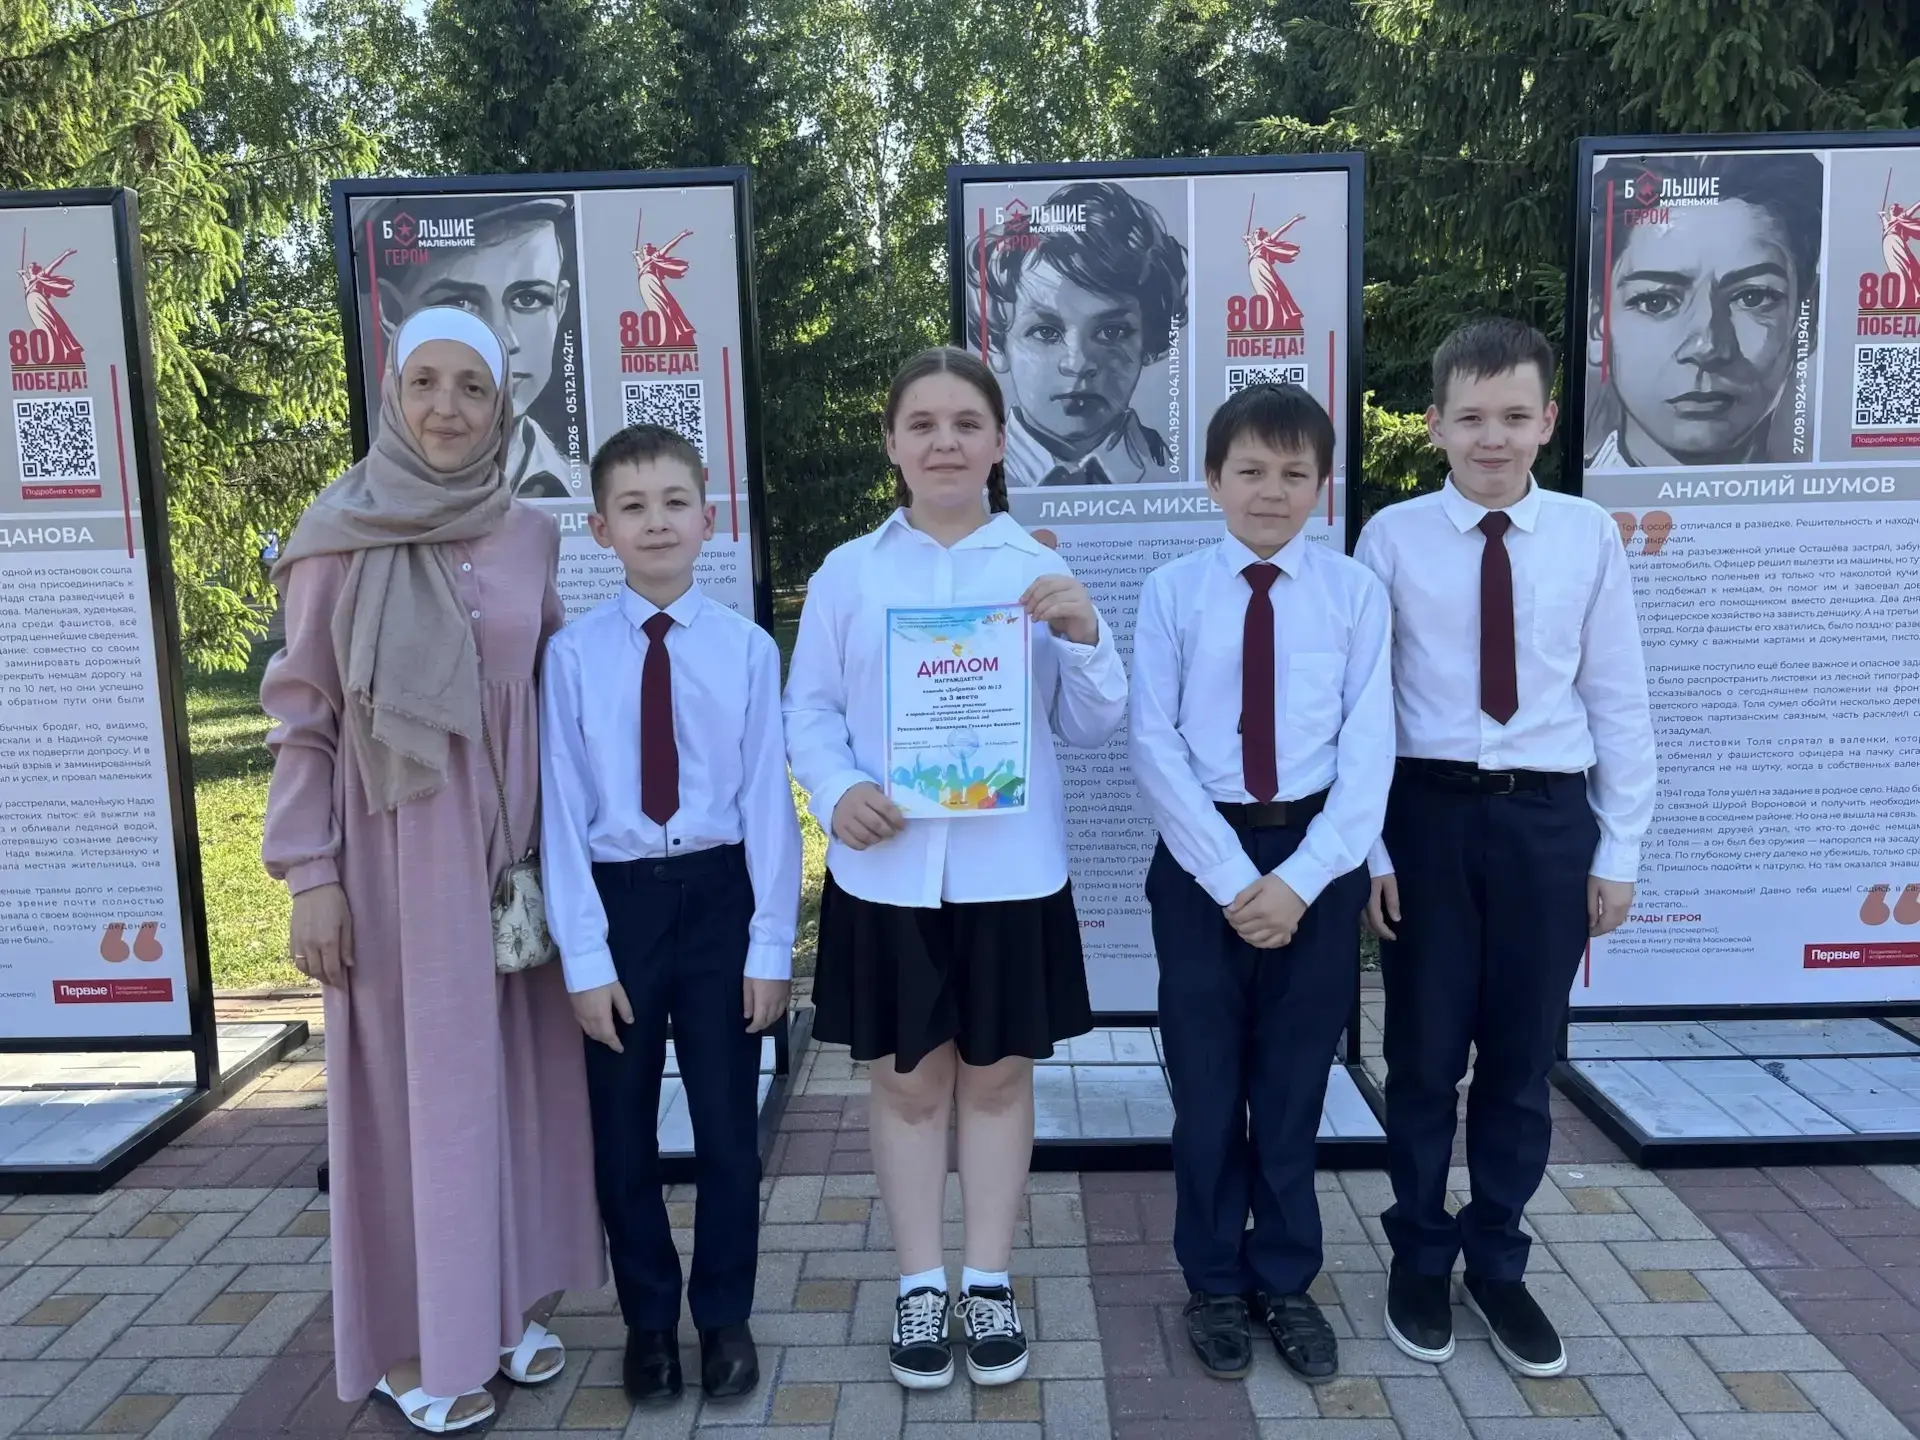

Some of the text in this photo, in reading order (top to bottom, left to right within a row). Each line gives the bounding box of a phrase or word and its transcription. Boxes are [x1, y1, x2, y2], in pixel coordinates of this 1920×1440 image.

[1659, 198, 1719, 207] МАЛЕНЬКИЕ
[1624, 207, 1669, 227] ГЕРОИ
[1029, 224, 1086, 233] МАЛЕНЬКИЕ
[418, 238, 476, 248] МАЛЕНЬКИЕ
[385, 248, 429, 267] ГЕРОИ
[1858, 272, 1900, 309] 80
[1227, 295, 1269, 331] 80
[619, 311, 662, 347] 80
[9, 328, 49, 365] 80
[1227, 336, 1305, 359] ПОБЕДА!
[621, 353, 700, 375] ПОБЕДА!
[12, 370, 88, 392] ПОБЕДА!
[1855, 434, 1898, 446] Подробнее
[568, 425, 582, 489] 05.11.1926
[25, 487, 66, 496] Подробнее
[1657, 474, 1896, 499] АНАТОЛИЙ ШУМОВ
[1039, 496, 1223, 518] ЛАРИСА МИХЕЕ
[0, 526, 94, 547] ДАНОВА
[1077, 540, 1133, 549] некоторые
[1152, 551, 1172, 560] Вот
[1650, 560, 1712, 570] автомобиль.
[1713, 560, 1756, 569] Офицер
[1757, 559, 1792, 568] решил
[1793, 558, 1834, 566] вылезти
[1849, 557, 1894, 565] машины,
[1895, 556, 1908, 564] но
[1, 568, 33, 577] одной
[47, 568, 99, 576] остановок
[1654, 574, 1707, 582] несколько
[1711, 573, 1760, 581] поленьев
[1840, 568, 1891, 578] наколотой
[1896, 570, 1918, 578] кучи
[40, 580, 124, 591] присоединилась
[714, 575, 737, 584] себя
[59, 592, 124, 603] разведчицей
[24, 606, 136, 616] Маленькая, худенькая,
[22, 621, 54, 630] среди
[59, 619, 114, 628] фашистов,
[1676, 625, 1705, 634] Когда
[1706, 625, 1752, 634] фашисты
[1754, 624, 1771, 632] его
[1773, 623, 1826, 631] хватились,
[1828, 621, 1854, 630] было
[1855, 622, 1893, 630] поздно:
[29, 632, 87, 642] ценнейшие
[88, 632, 138, 641] сведения.
[5, 656, 141, 668] заминировать дорожный
[917, 657, 998, 678] ДИПЛОМ
[1649, 664, 1701, 673] парнишке
[1702, 663, 1756, 672] поступило
[1780, 660, 1810, 669] более
[1812, 661, 1849, 669] важное
[1859, 660, 1900, 668] опасное
[934, 676, 983, 684] НАГРАЖДАЕТСЯ
[24, 684, 35, 693] 10
[38, 685, 57, 693] лет,
[99, 684, 144, 693] успешно
[7, 695, 145, 707] обратном пути они были
[1065, 764, 1114, 774] 1943 года
[1663, 789, 1682, 798] 1941
[1683, 790, 1706, 798] года
[1707, 788, 1730, 797] Толя
[1772, 788, 1813, 796] задание
[1822, 787, 1858, 796] родное
[1886, 786, 1910, 794] Надо
[1069, 804, 1107, 813] родной
[47, 812, 78, 820] пыток:
[83, 810, 96, 819] ей
[101, 811, 139, 819] выжгли
[1078, 829, 1145, 838] оба погибли.
[5, 850, 30, 859] Надя
[81, 848, 148, 858] Истерзанную
[1657, 863, 1709, 873] Пришлось
[1711, 862, 1752, 872] подойти
[1763, 863, 1806, 872] патрулю.
[1844, 861, 1887, 869] оказался
[1078, 882, 1111, 891] прямо
[1666, 914, 1701, 922] ГЕРОЯ
[1811, 949, 1860, 963] Первые
[60, 985, 108, 998] Первые
